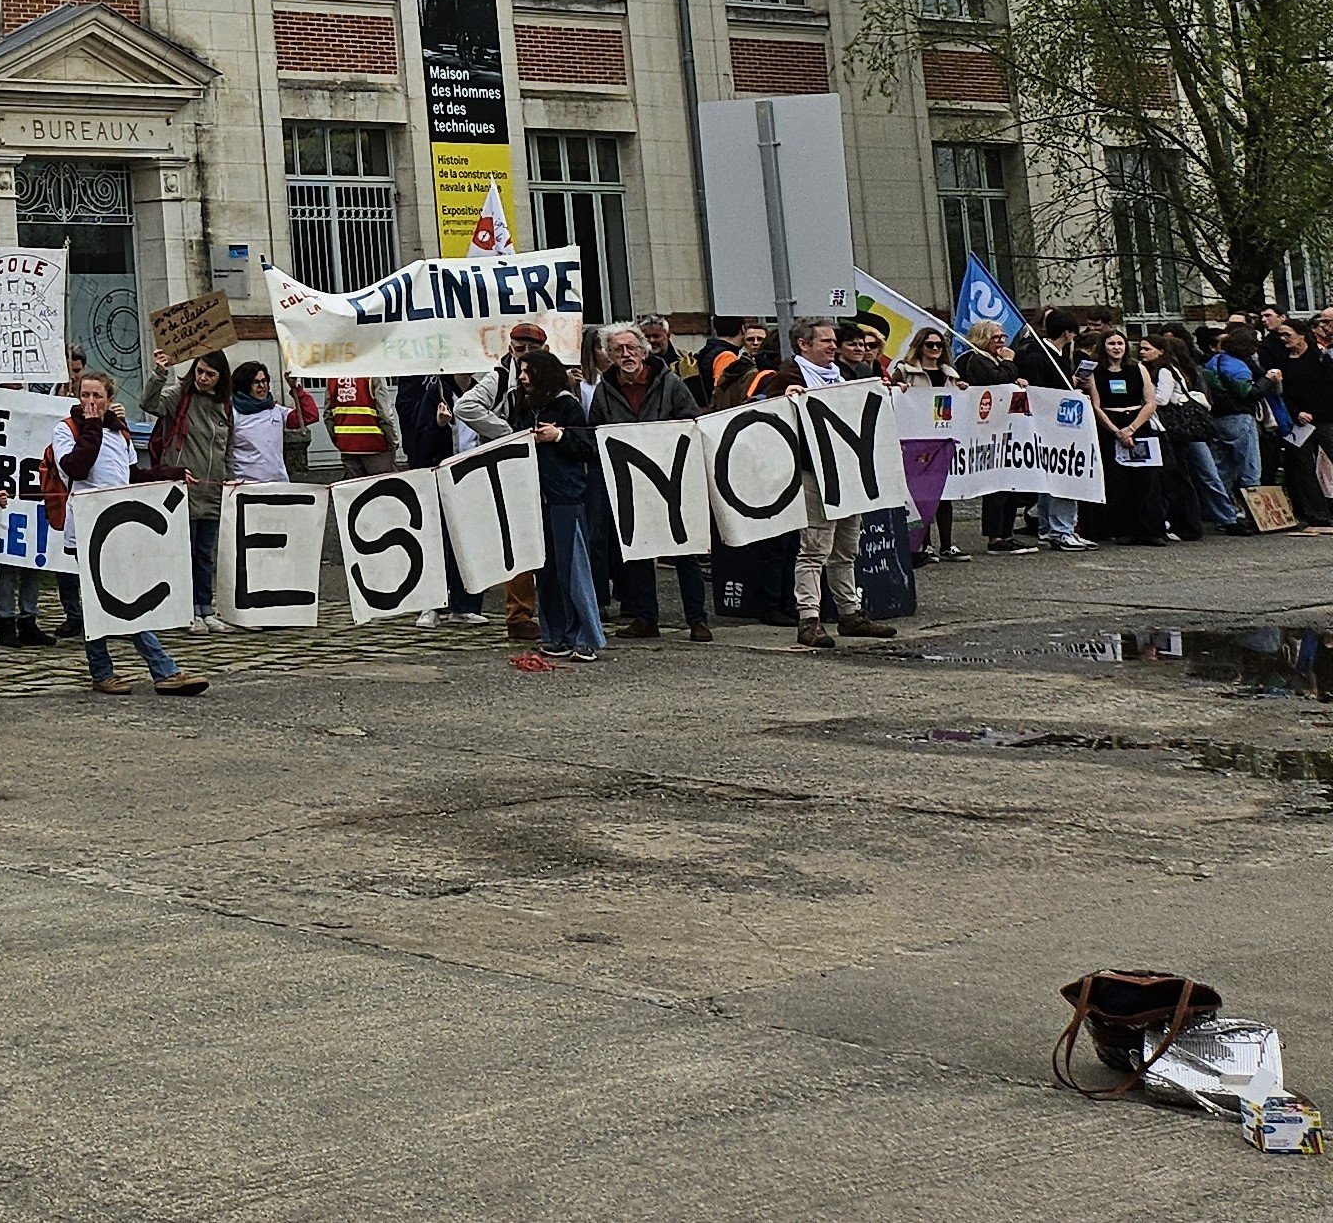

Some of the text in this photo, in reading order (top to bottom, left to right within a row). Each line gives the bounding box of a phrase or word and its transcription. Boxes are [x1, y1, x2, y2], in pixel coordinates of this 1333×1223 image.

[429, 65, 470, 81] Maison
[431, 83, 502, 100] des Hommes
[433, 101, 467, 116] et des
[32, 119, 140, 144] BUREAUX
[434, 119, 496, 137] techniques
[437, 154, 469, 166] Histoire
[438, 168, 449, 179] de
[449, 168, 458, 179] la
[439, 182, 466, 193] navale
[467, 181, 473, 193] à
[346, 260, 582, 326] COLINIÈRE
[86, 444, 531, 622] C'EST
[604, 392, 884, 548] NON
